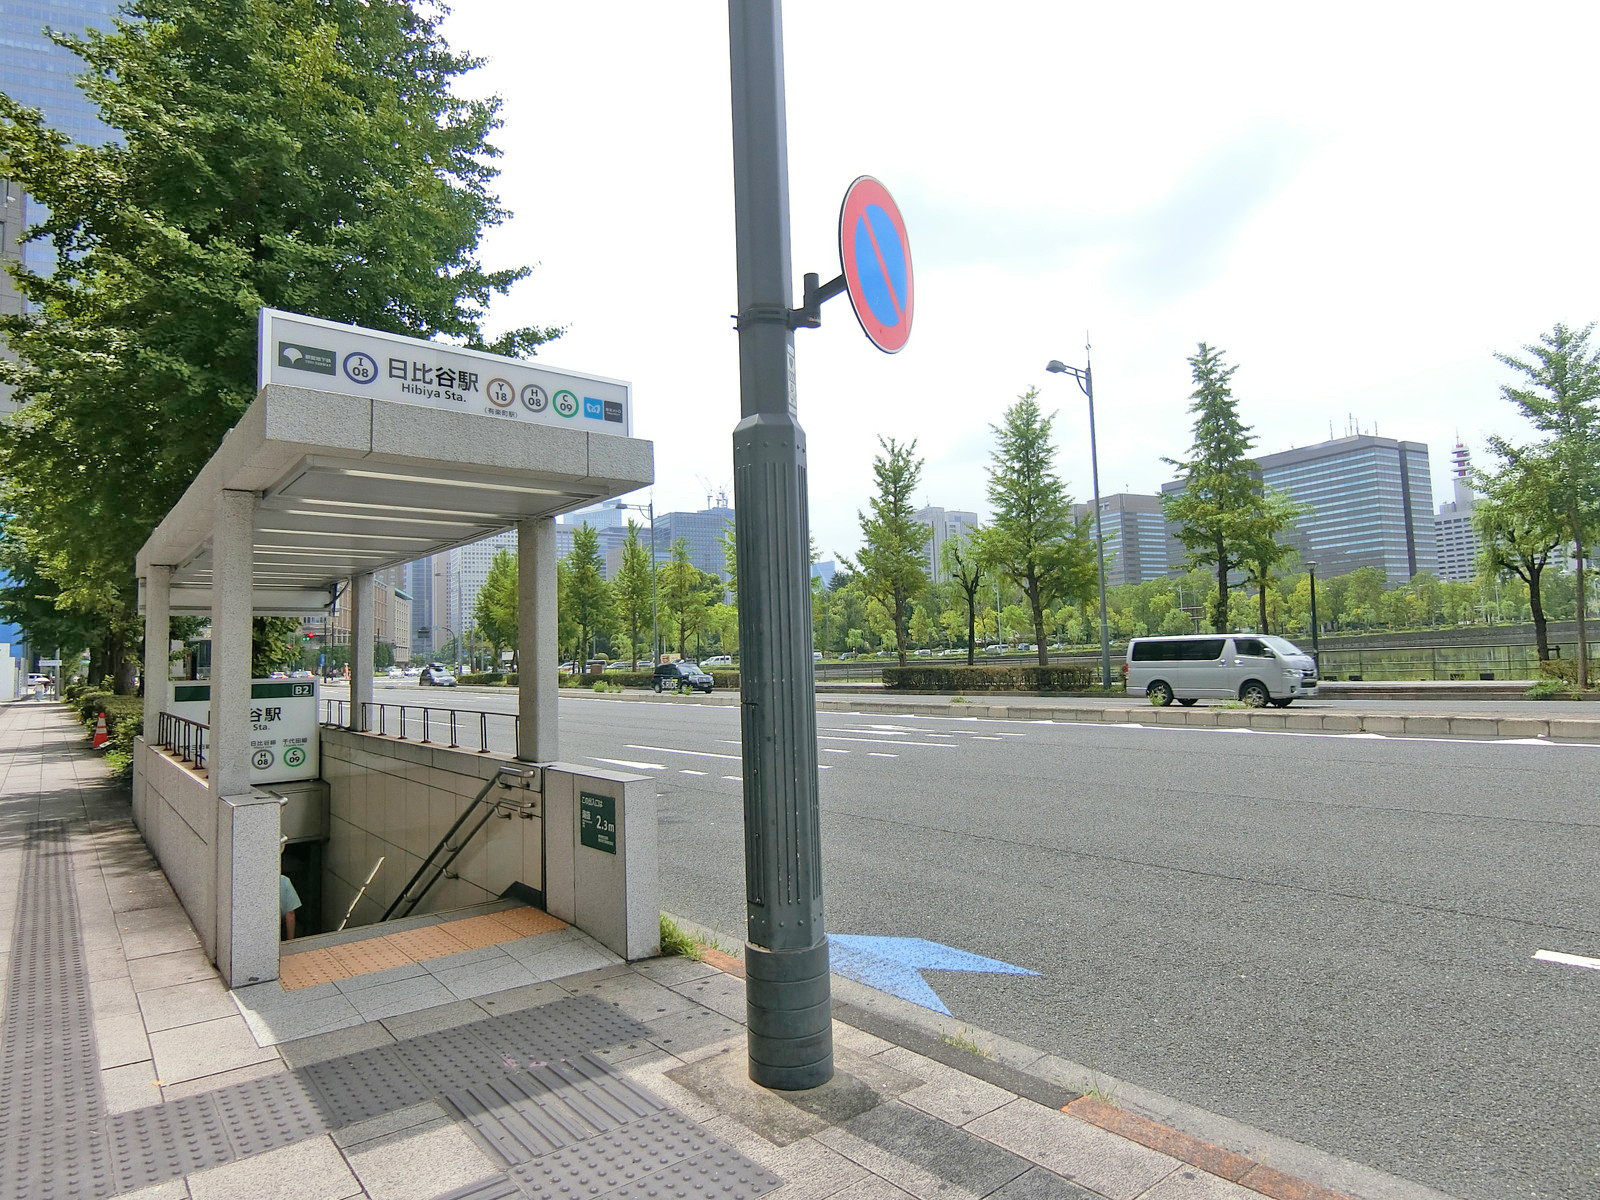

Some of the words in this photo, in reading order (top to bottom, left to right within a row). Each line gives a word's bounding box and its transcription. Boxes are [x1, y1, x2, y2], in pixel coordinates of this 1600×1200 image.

[358, 357, 364, 367] I
[352, 366, 369, 378] 08
[389, 357, 479, 393] 日比谷駅
[497, 382, 505, 391] Y
[401, 382, 441, 399] Hibiya
[444, 390, 467, 403] Sta.
[495, 391, 508, 402] 18
[531, 389, 539, 398] H
[528, 397, 542, 407] 08
[562, 394, 569, 402] C
[559, 402, 573, 413] 09
[295, 685, 310, 695] B2
[250, 707, 282, 722] 谷駅
[253, 723, 270, 731] Sta.
[289, 756, 300, 764] 09
